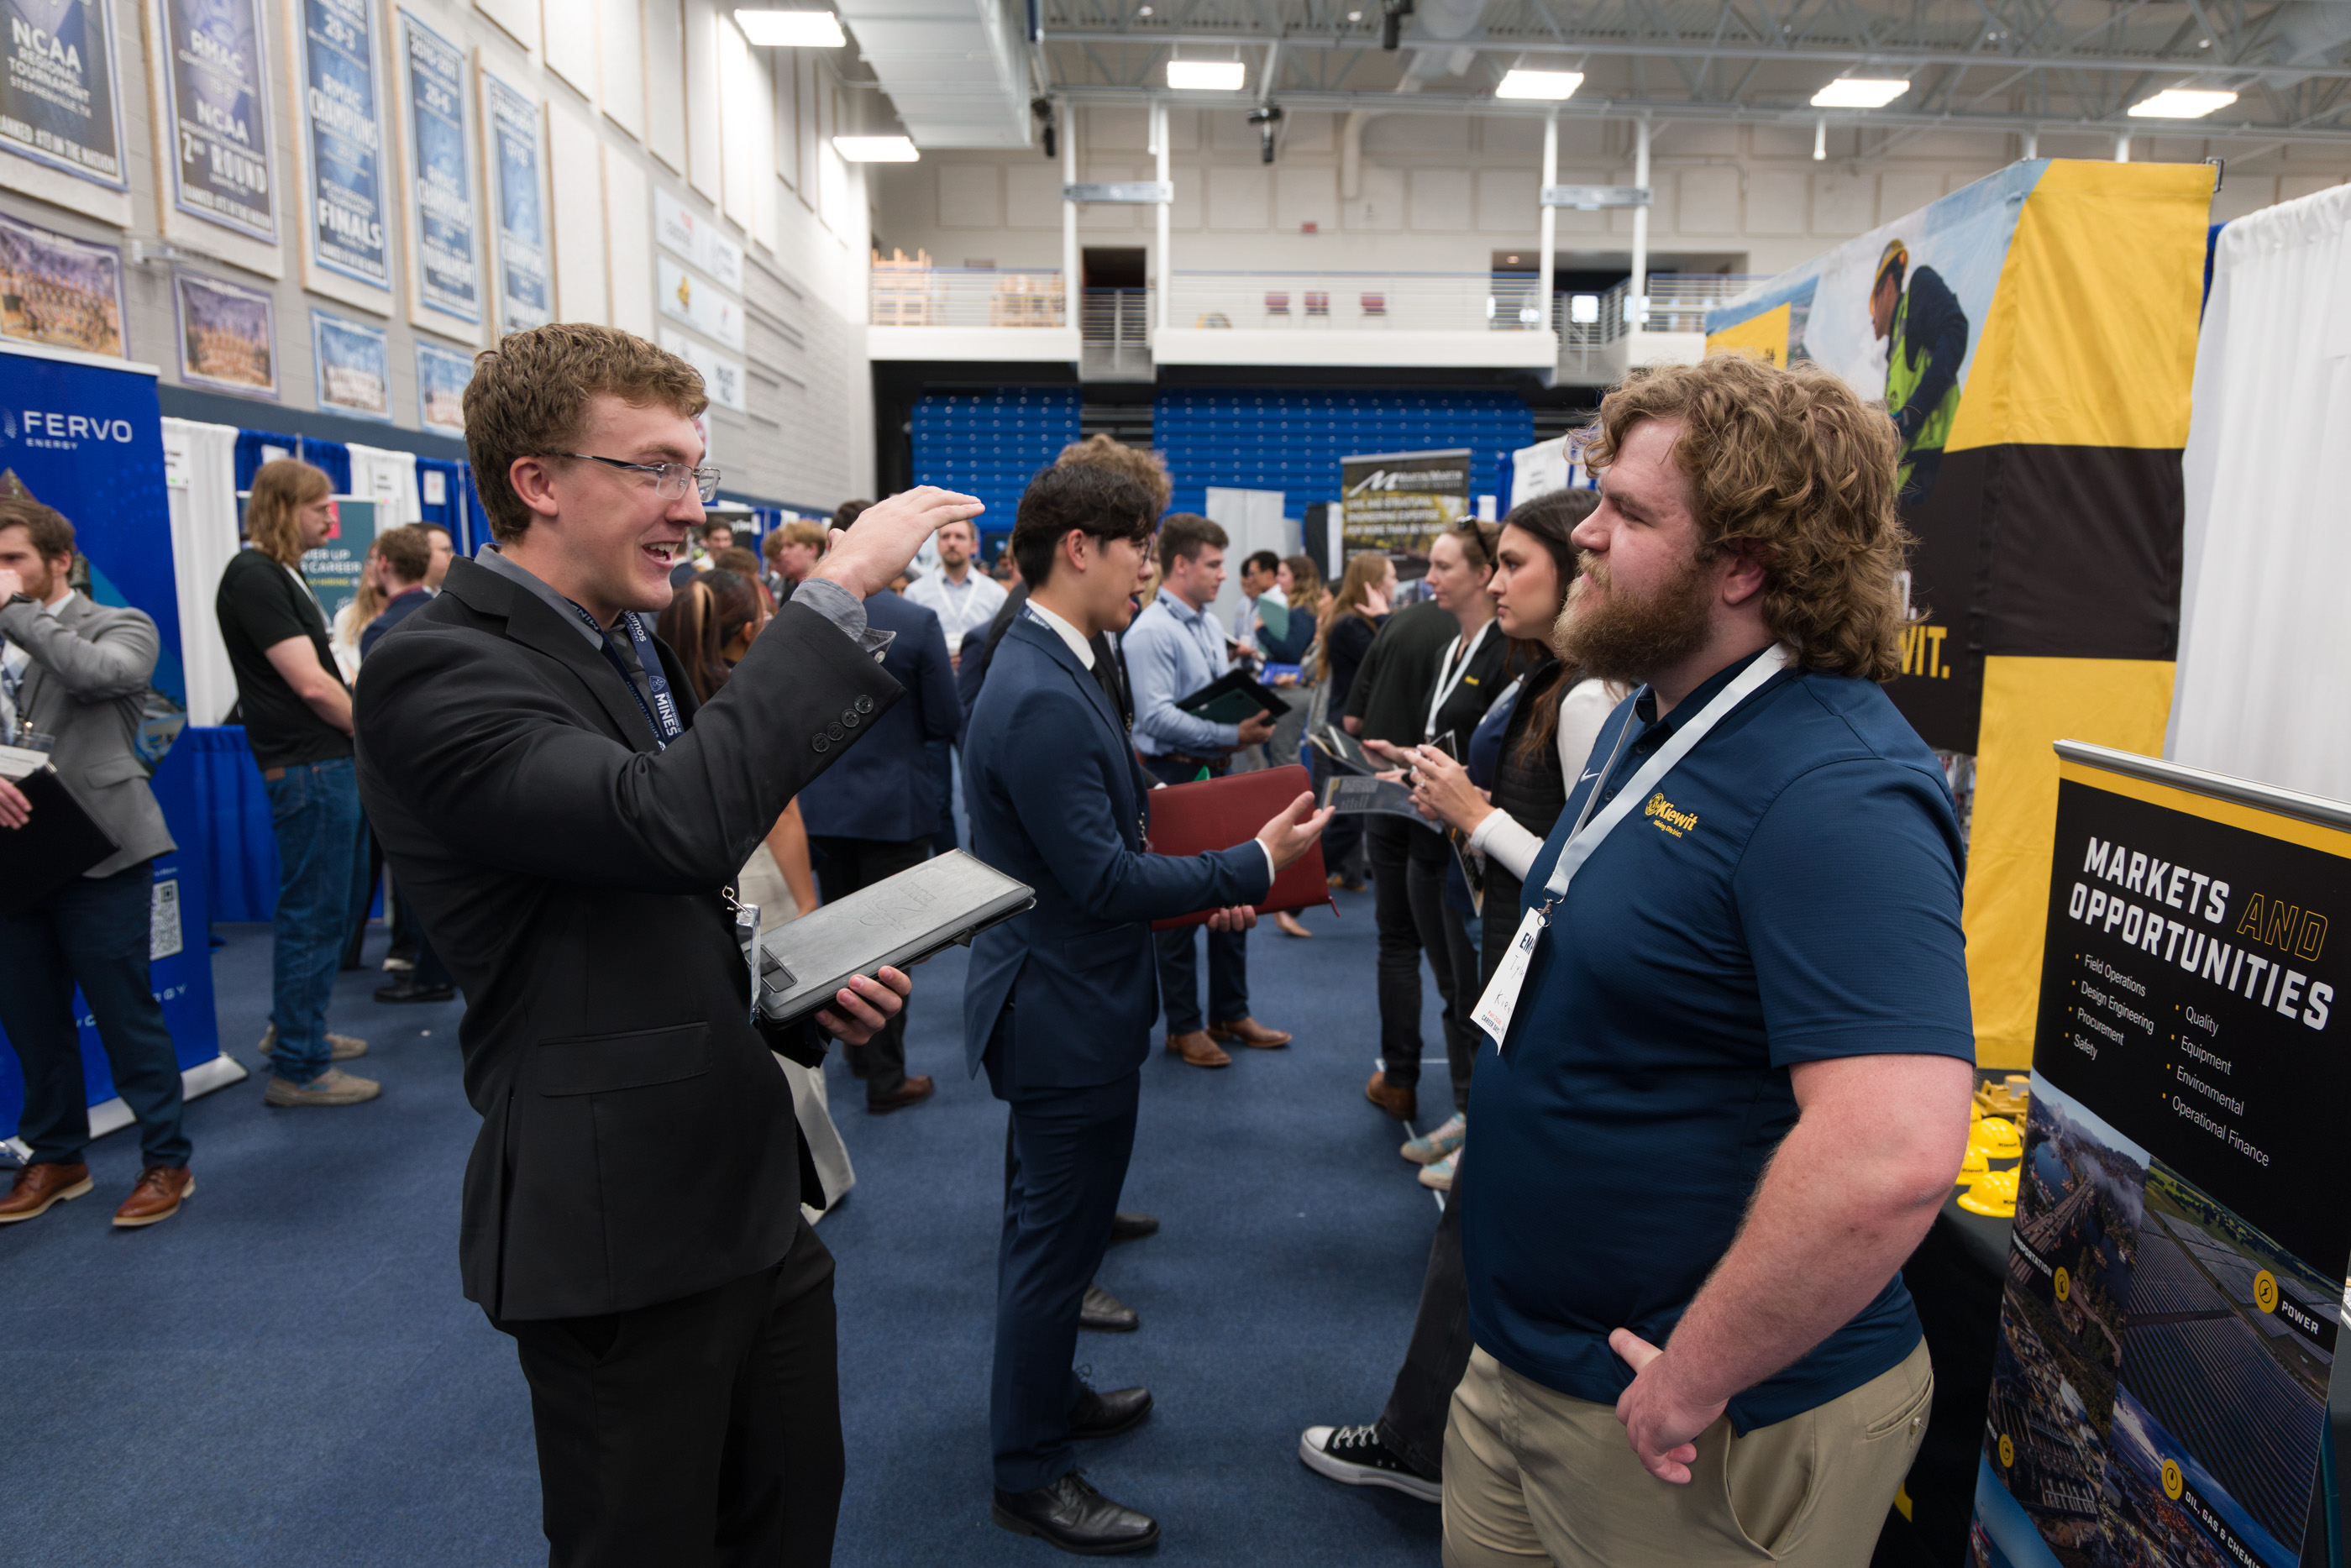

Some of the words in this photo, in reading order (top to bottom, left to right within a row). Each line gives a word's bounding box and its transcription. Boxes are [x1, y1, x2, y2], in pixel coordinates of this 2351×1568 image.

[12, 16, 82, 74] NCAA
[18, 45, 80, 87] REGIONAL
[191, 29, 244, 77] RMAC
[8, 56, 91, 104] TOURNAMENT
[0, 114, 34, 144] ANKED
[196, 97, 250, 145] NCAA
[211, 144, 268, 195] ROUND
[317, 197, 384, 250] FINALS
[24, 410, 133, 443] FERVO
[25, 437, 79, 451] ENERGY
[309, 561, 362, 574] CAREER
[331, 548, 351, 562] UP
[645, 713, 660, 738] NATIONAL
[654, 692, 678, 737] MINES
[1655, 800, 1699, 831] Kiewit
[2083, 836, 2230, 924] MARKETS
[2236, 892, 2328, 962] AND
[2069, 882, 2334, 1031] OPPORTUNITIES
[2084, 953, 2104, 974] Field
[2104, 964, 2146, 998] Operations
[1481, 1014, 1494, 1029] CAREER
[2077, 1007, 2125, 1046] Procurement
[2081, 980, 2107, 1006] Design
[2108, 994, 2154, 1036] Engineering
[2186, 1005, 2219, 1037] Quality
[2073, 1033, 2098, 1061] Safety
[2181, 1035, 2233, 1076] Equipment
[2176, 1064, 2245, 1117] Environmental
[2172, 1095, 2228, 1141] Operational
[2228, 1129, 2270, 1167] Finance
[2281, 1300, 2320, 1335] POWER
[2185, 1491, 2201, 1515] OIL,
[2201, 1508, 2219, 1533] GAS
[2219, 1528, 2227, 1540] &
